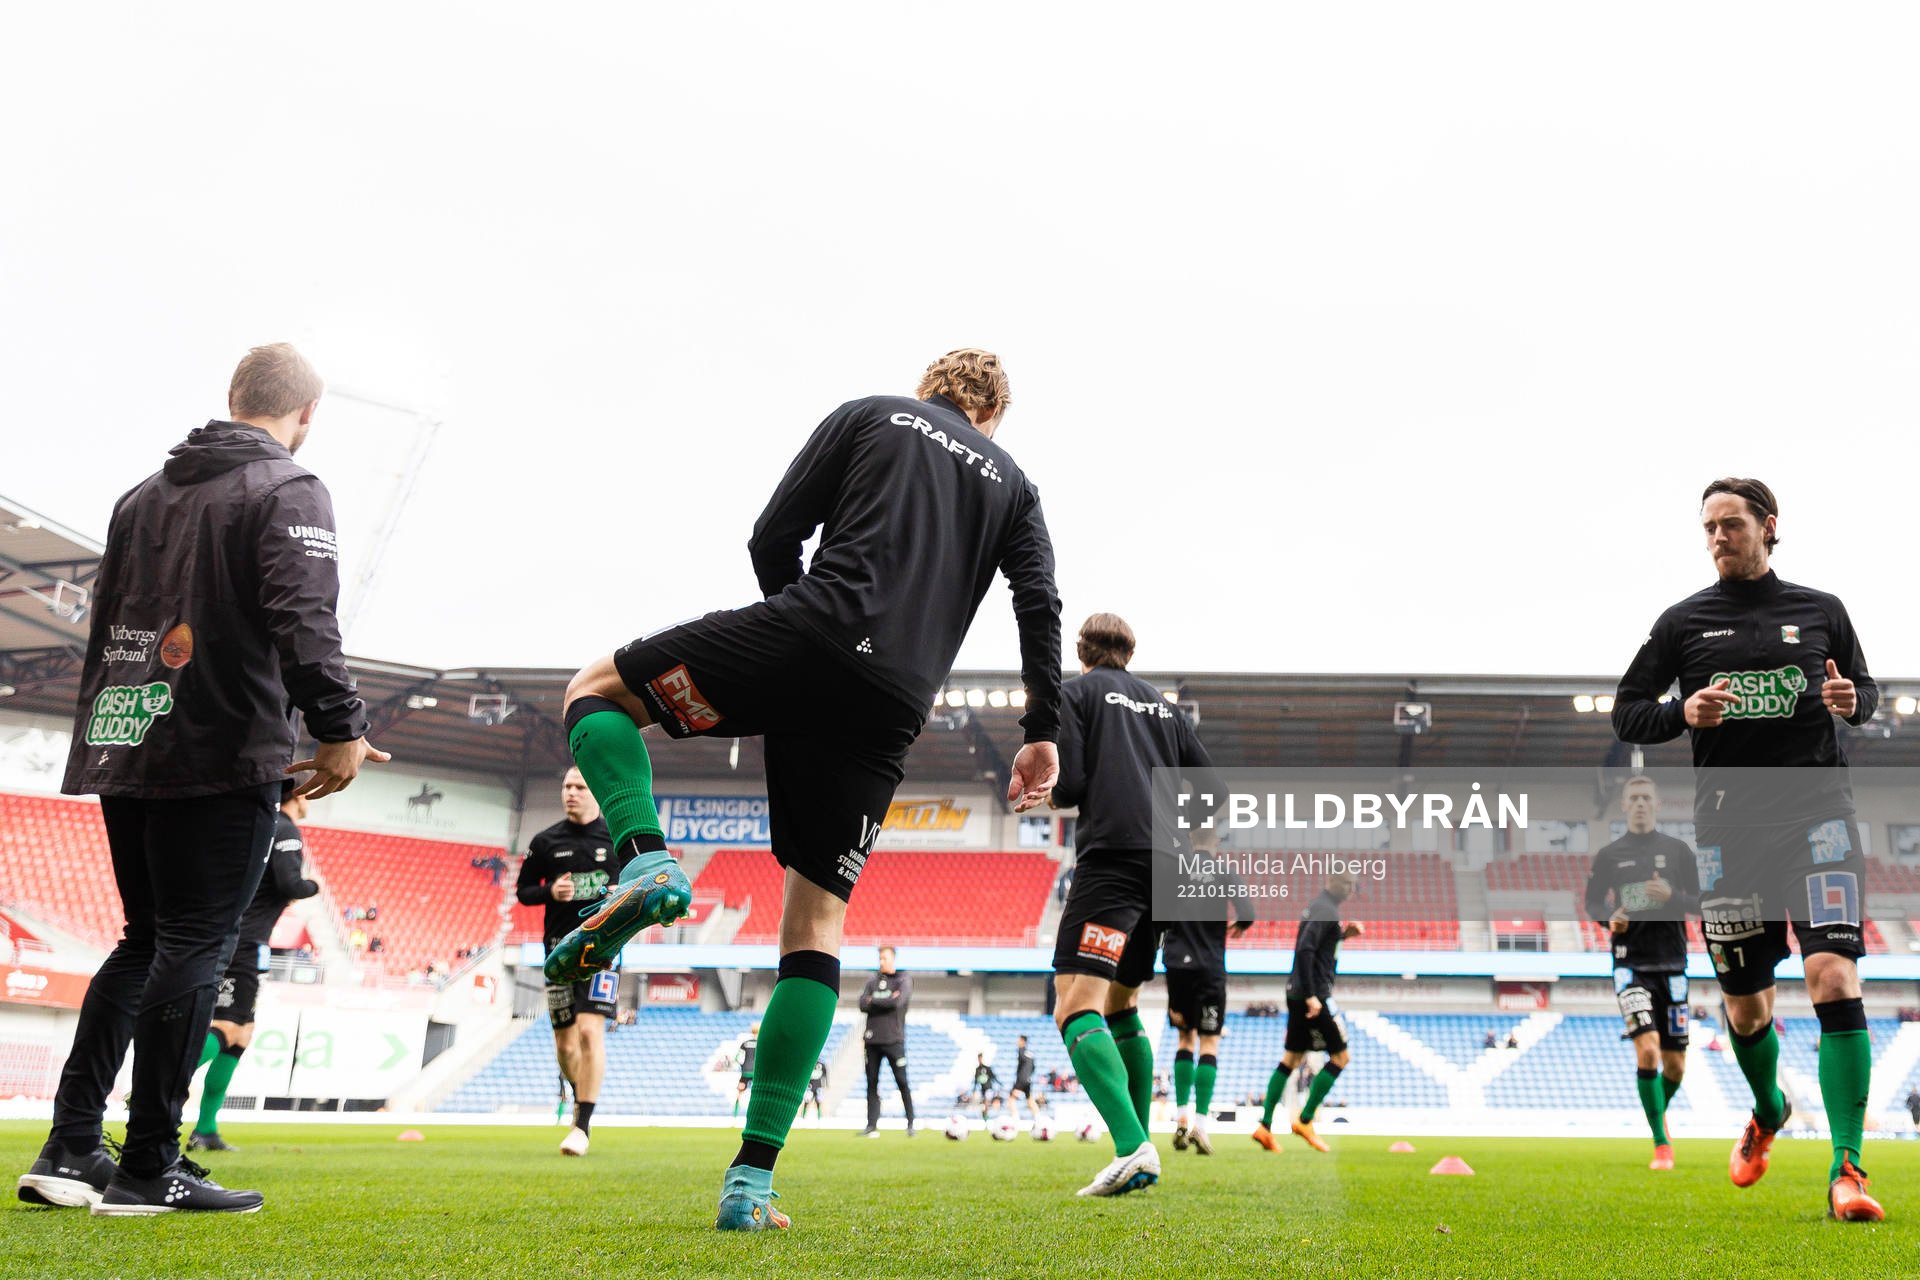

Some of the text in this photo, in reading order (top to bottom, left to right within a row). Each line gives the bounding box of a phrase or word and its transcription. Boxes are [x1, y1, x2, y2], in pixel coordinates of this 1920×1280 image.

[890, 412, 984, 465] CRAFT
[287, 525, 336, 545] UNIBE
[305, 550, 333, 559] CRAFT
[1703, 630, 1728, 638] CRAFT
[98, 691, 138, 715] CASH
[662, 669, 720, 723] FMP
[1105, 692, 1158, 715] CRAFT
[91, 716, 149, 740] BUDDY
[661, 798, 769, 818] ELSINGBO
[1715, 789, 1726, 811] 7
[1083, 925, 1126, 952] FMP
[1733, 947, 1744, 968] 7
